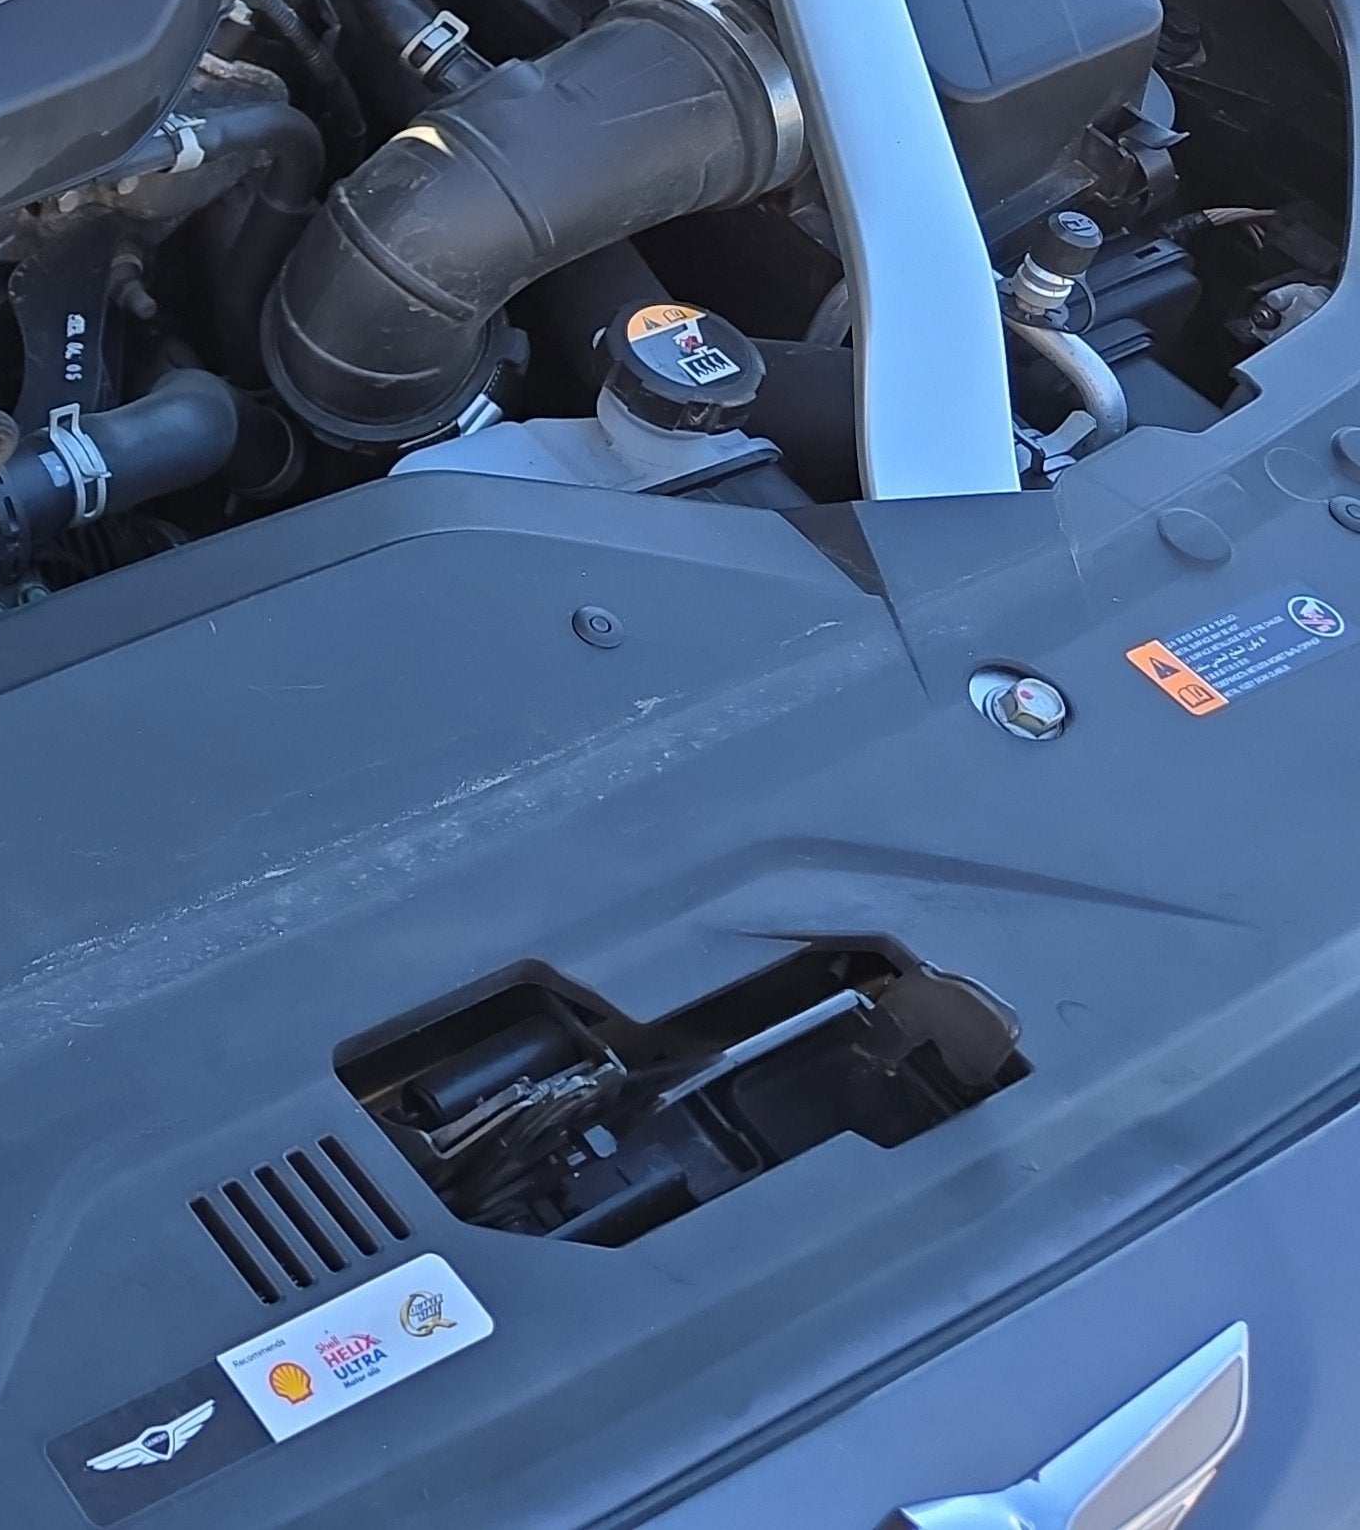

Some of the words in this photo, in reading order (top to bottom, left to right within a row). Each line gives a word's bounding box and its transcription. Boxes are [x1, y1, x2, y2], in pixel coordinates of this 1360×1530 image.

[231, 1338, 286, 1368] Recommends
[315, 1335, 341, 1355] Shell
[323, 1335, 378, 1368] HELIX
[333, 1348, 388, 1380] ULTRA
